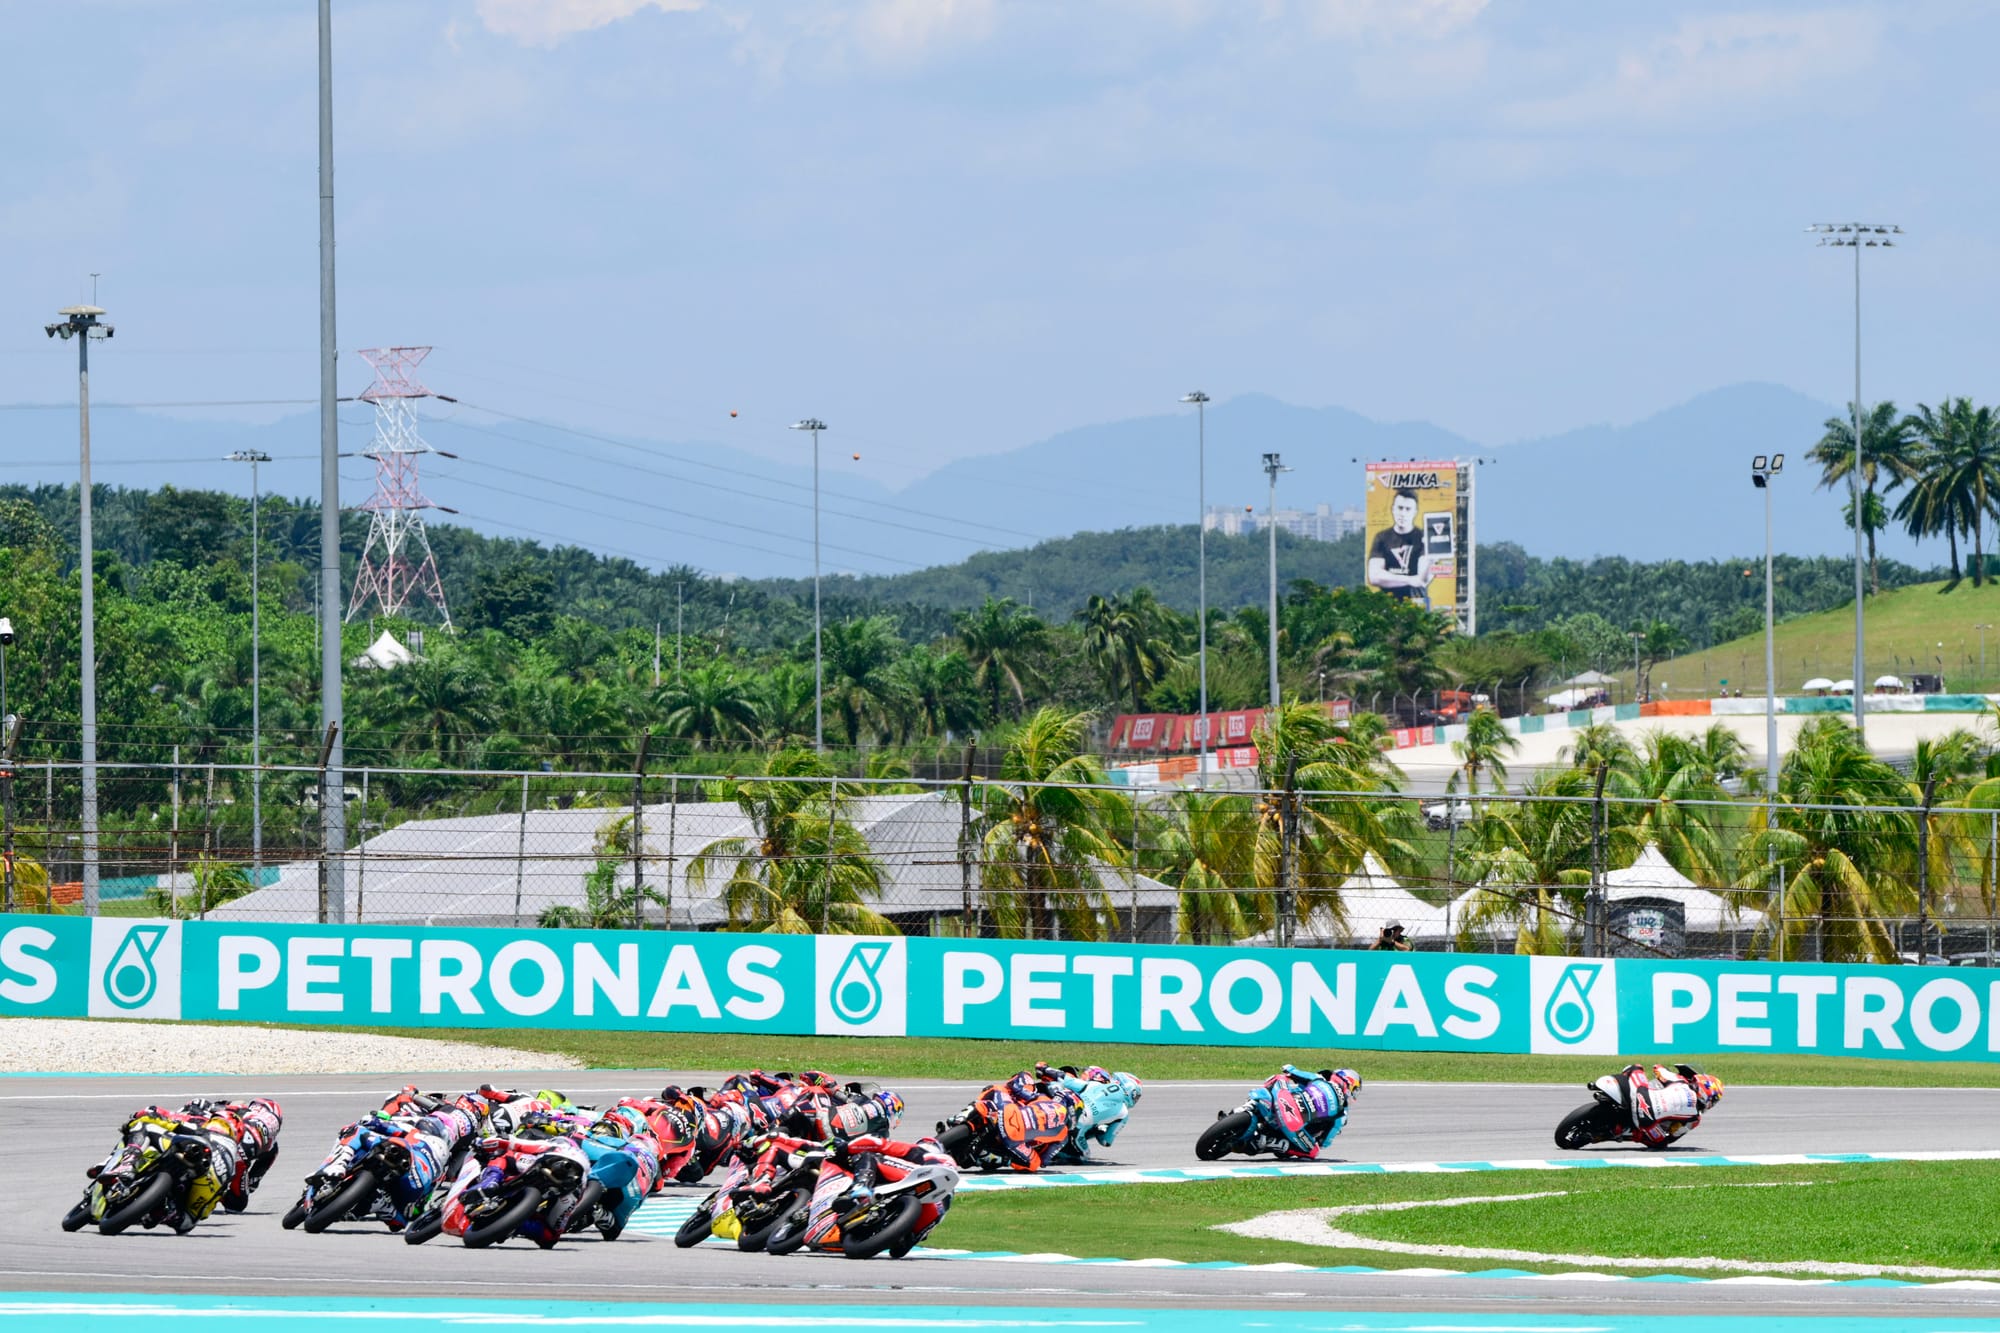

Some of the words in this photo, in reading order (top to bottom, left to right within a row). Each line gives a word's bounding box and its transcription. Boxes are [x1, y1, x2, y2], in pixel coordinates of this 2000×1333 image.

[1135, 721, 1152, 736] LEO
[1231, 719, 1244, 731] LEO
[218, 935, 784, 1018] PETRONAS
[943, 951, 1500, 1040] PETRONAS
